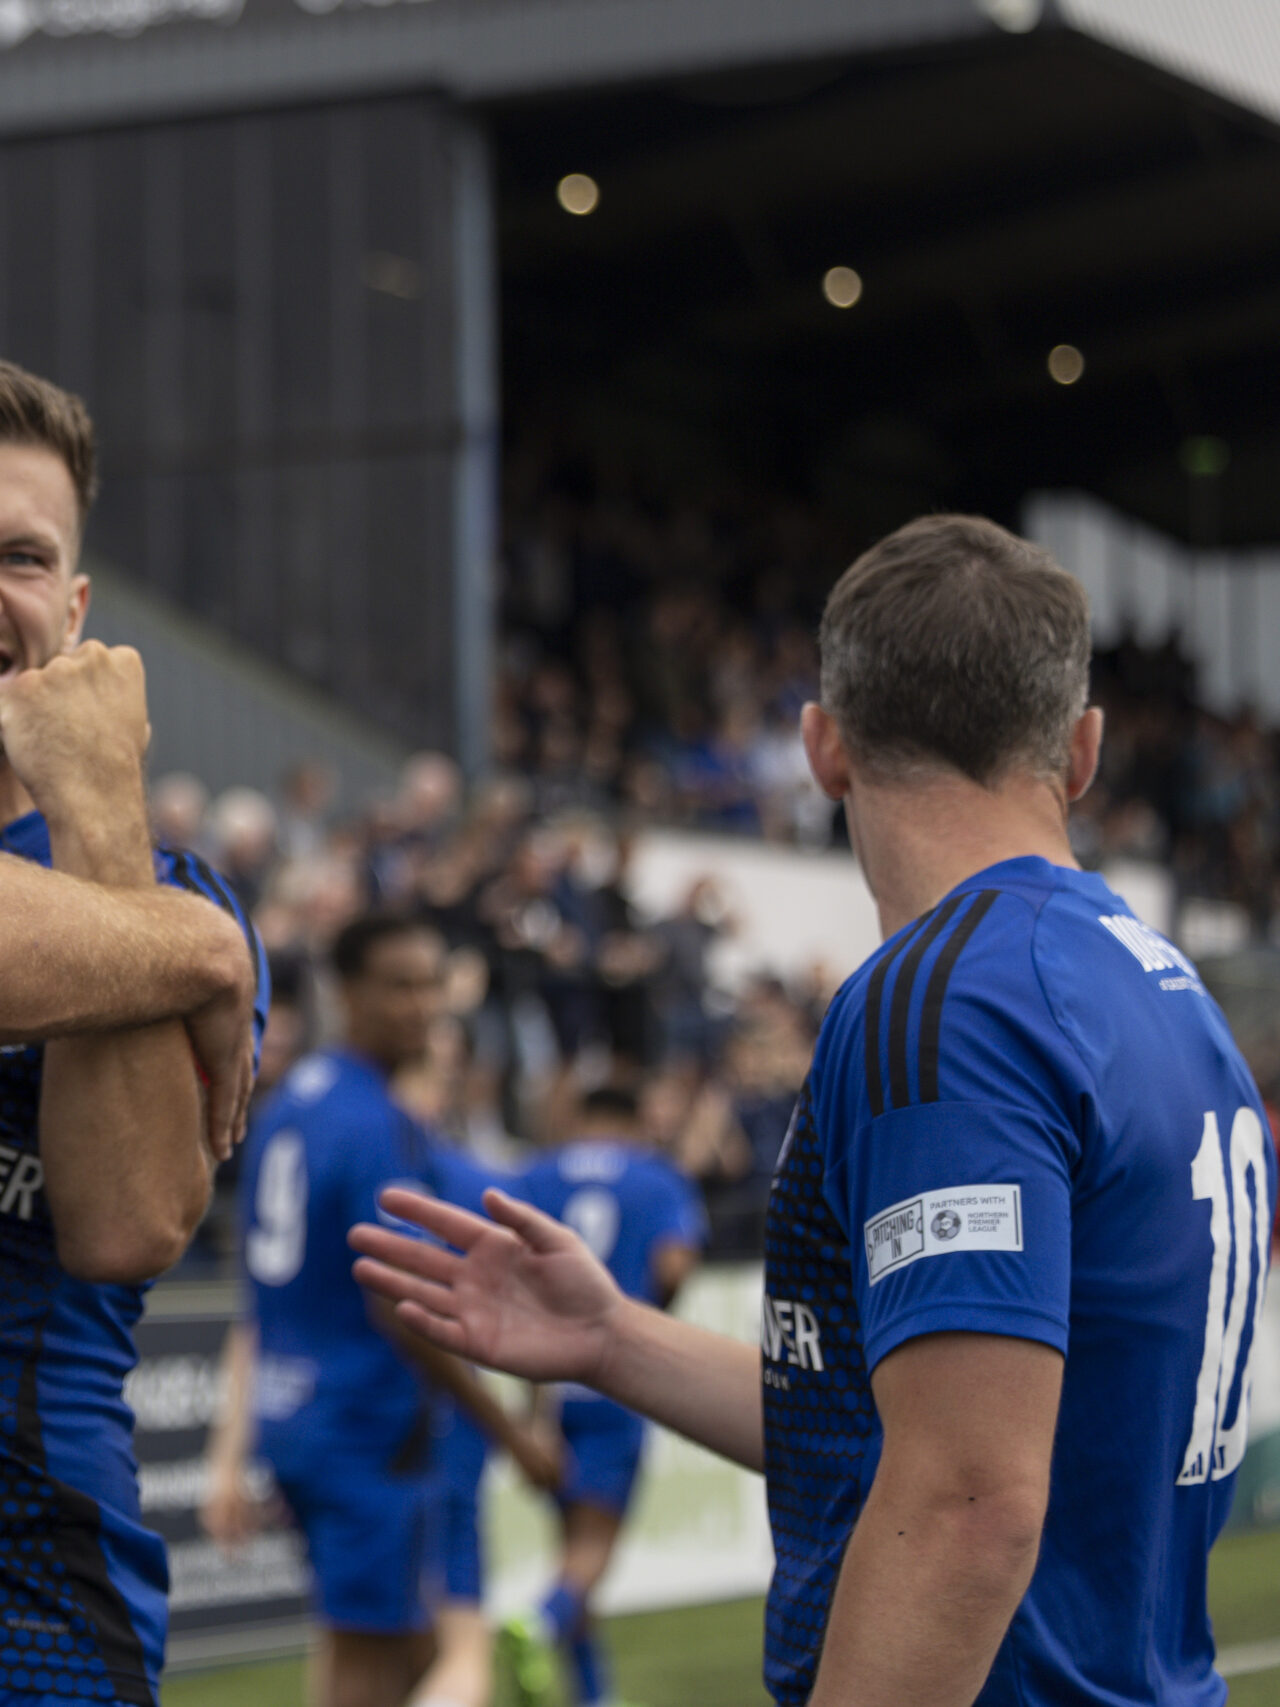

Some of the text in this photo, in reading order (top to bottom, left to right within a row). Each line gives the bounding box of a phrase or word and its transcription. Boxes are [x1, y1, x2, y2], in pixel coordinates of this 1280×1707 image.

[930, 1195, 1006, 1210] PARTNERS WITH
[967, 1211, 1009, 1219] NORTHERN
[968, 1218, 1001, 1226] PREMIER
[872, 1209, 914, 1250] PITCHING
[967, 1225, 997, 1233] LEAGUE
[890, 1237, 903, 1260] IN
[1176, 1105, 1270, 1487] 10
